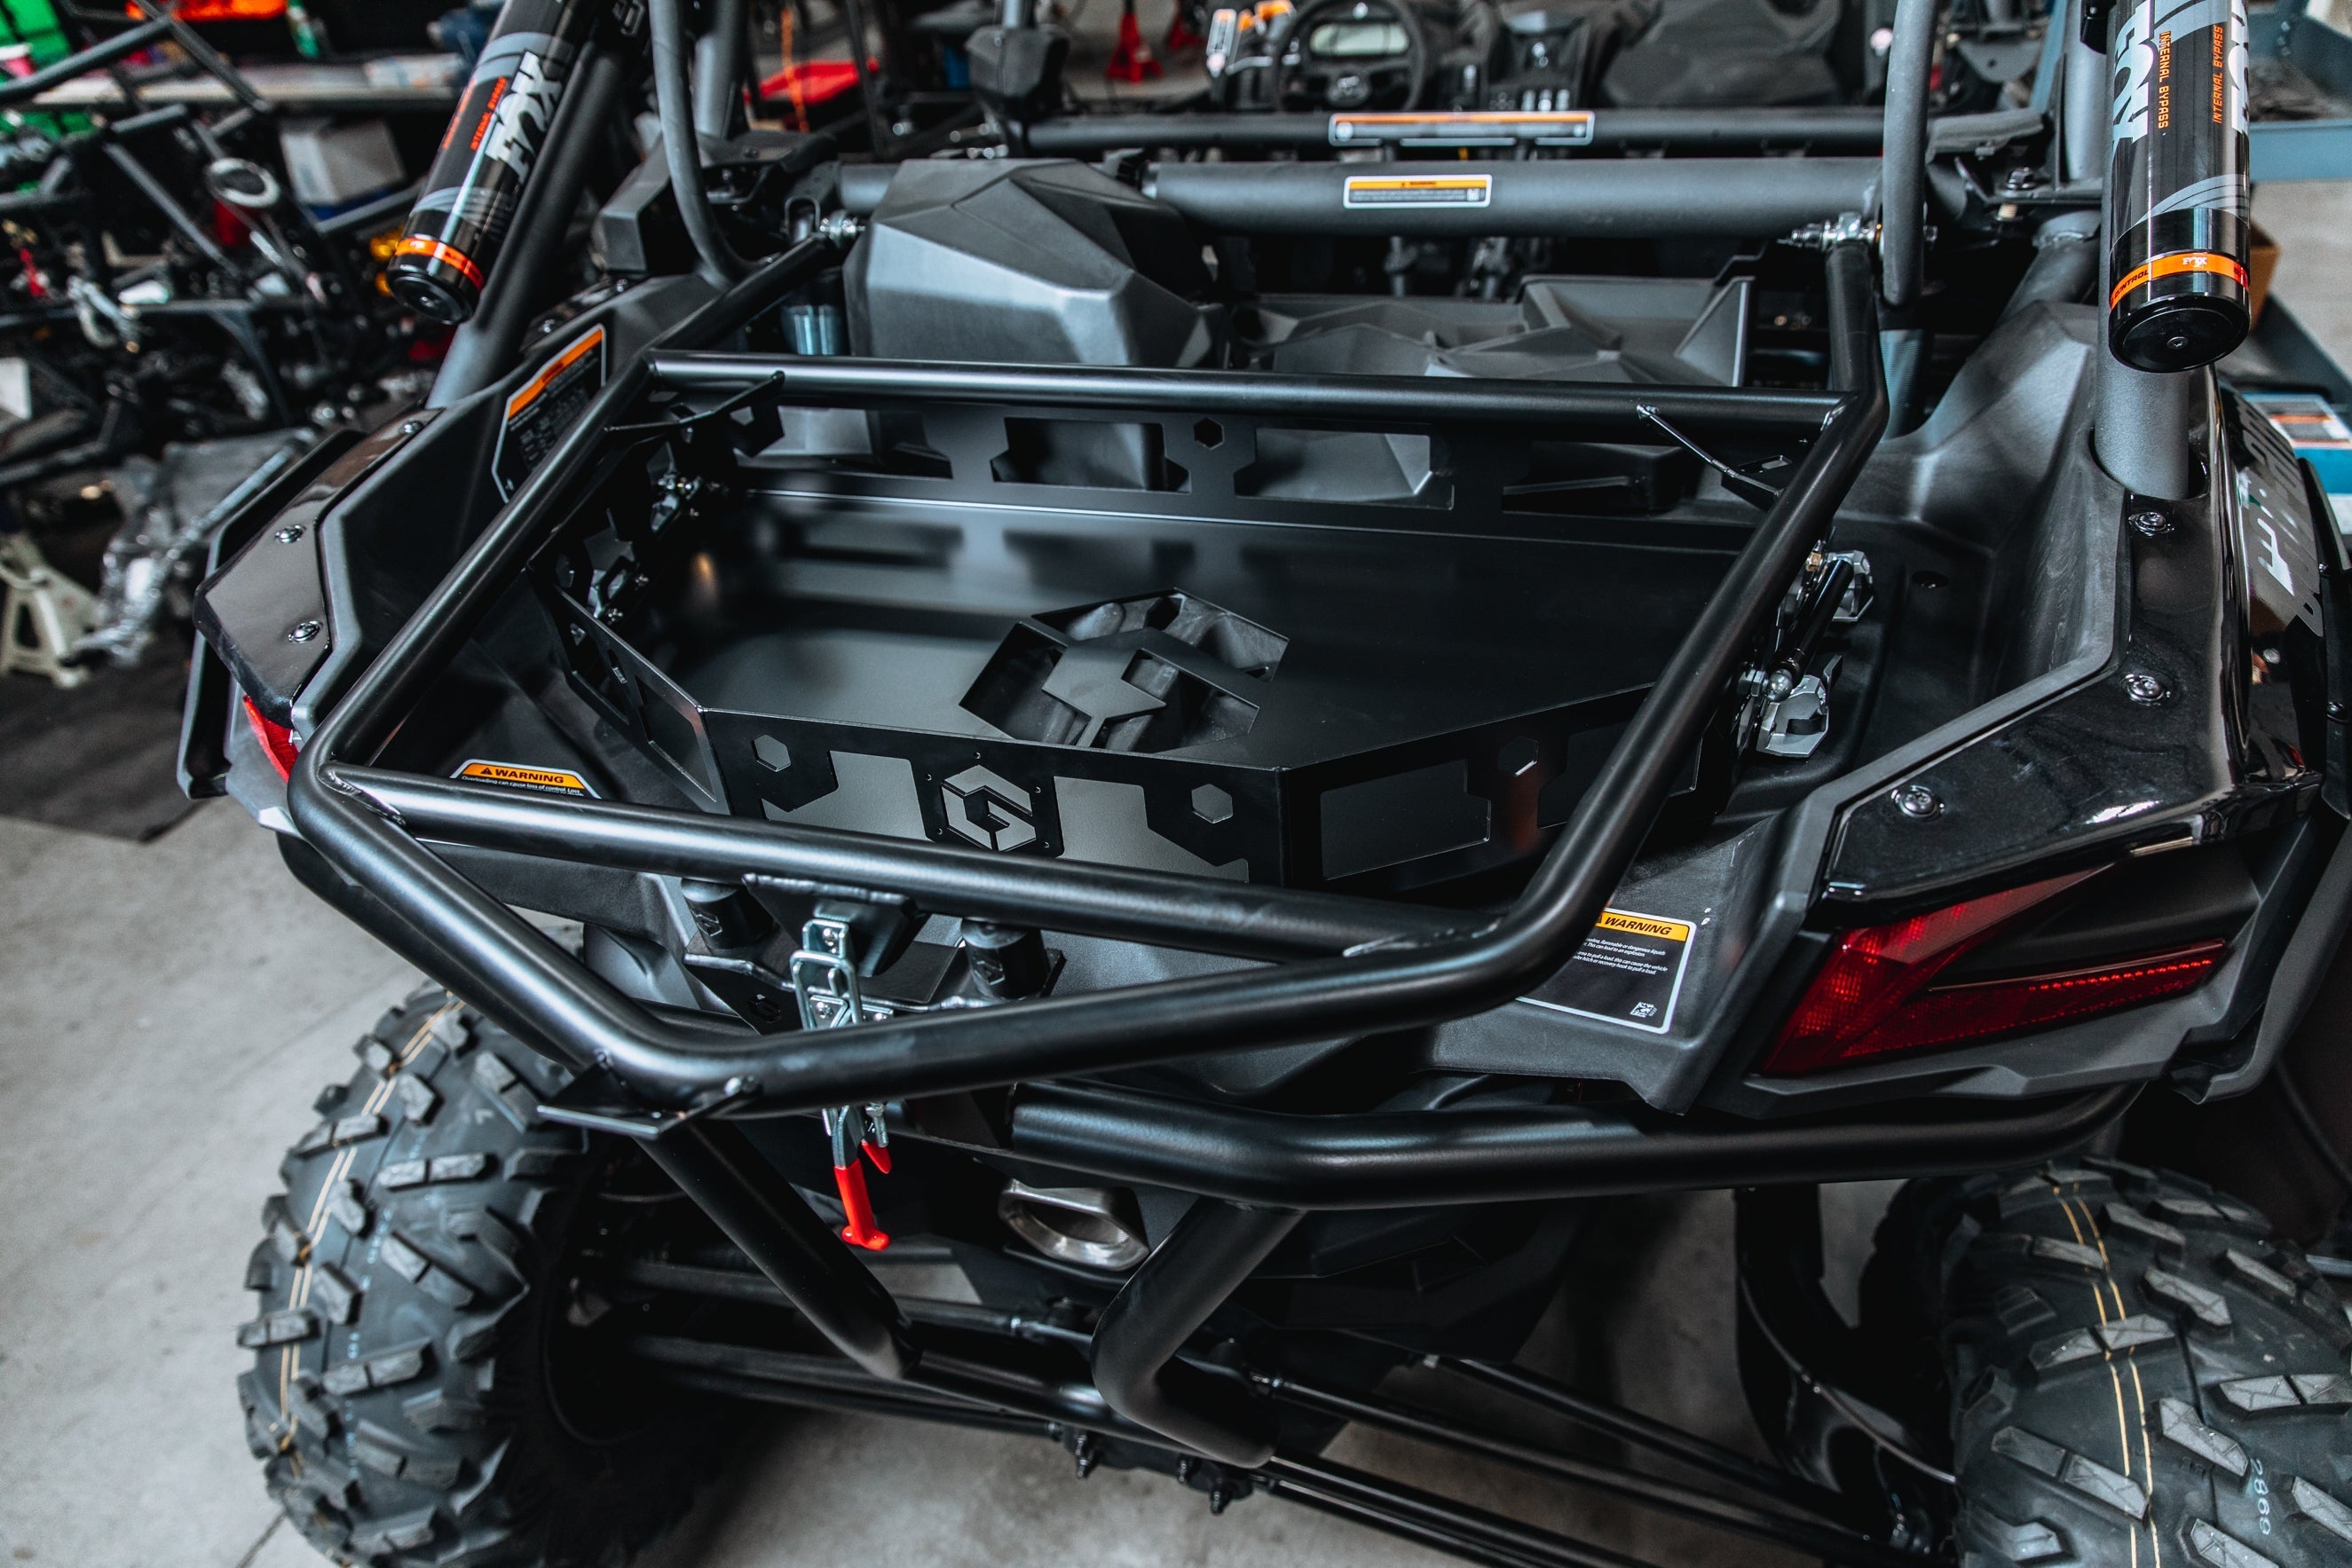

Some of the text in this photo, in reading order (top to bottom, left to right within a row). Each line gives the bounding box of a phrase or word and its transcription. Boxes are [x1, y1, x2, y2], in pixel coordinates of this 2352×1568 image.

[2111, 0, 2153, 162] FOX
[2158, 30, 2172, 130] INTERNAL BYPASS
[2212, 25, 2223, 124] INTERNAL BYPASS
[484, 51, 563, 185] FOX
[2114, 269, 2149, 300] CONTROL
[2182, 256, 2208, 267] FOX
[495, 768, 564, 784] WARNING
[1604, 917, 1672, 935] WARNING
